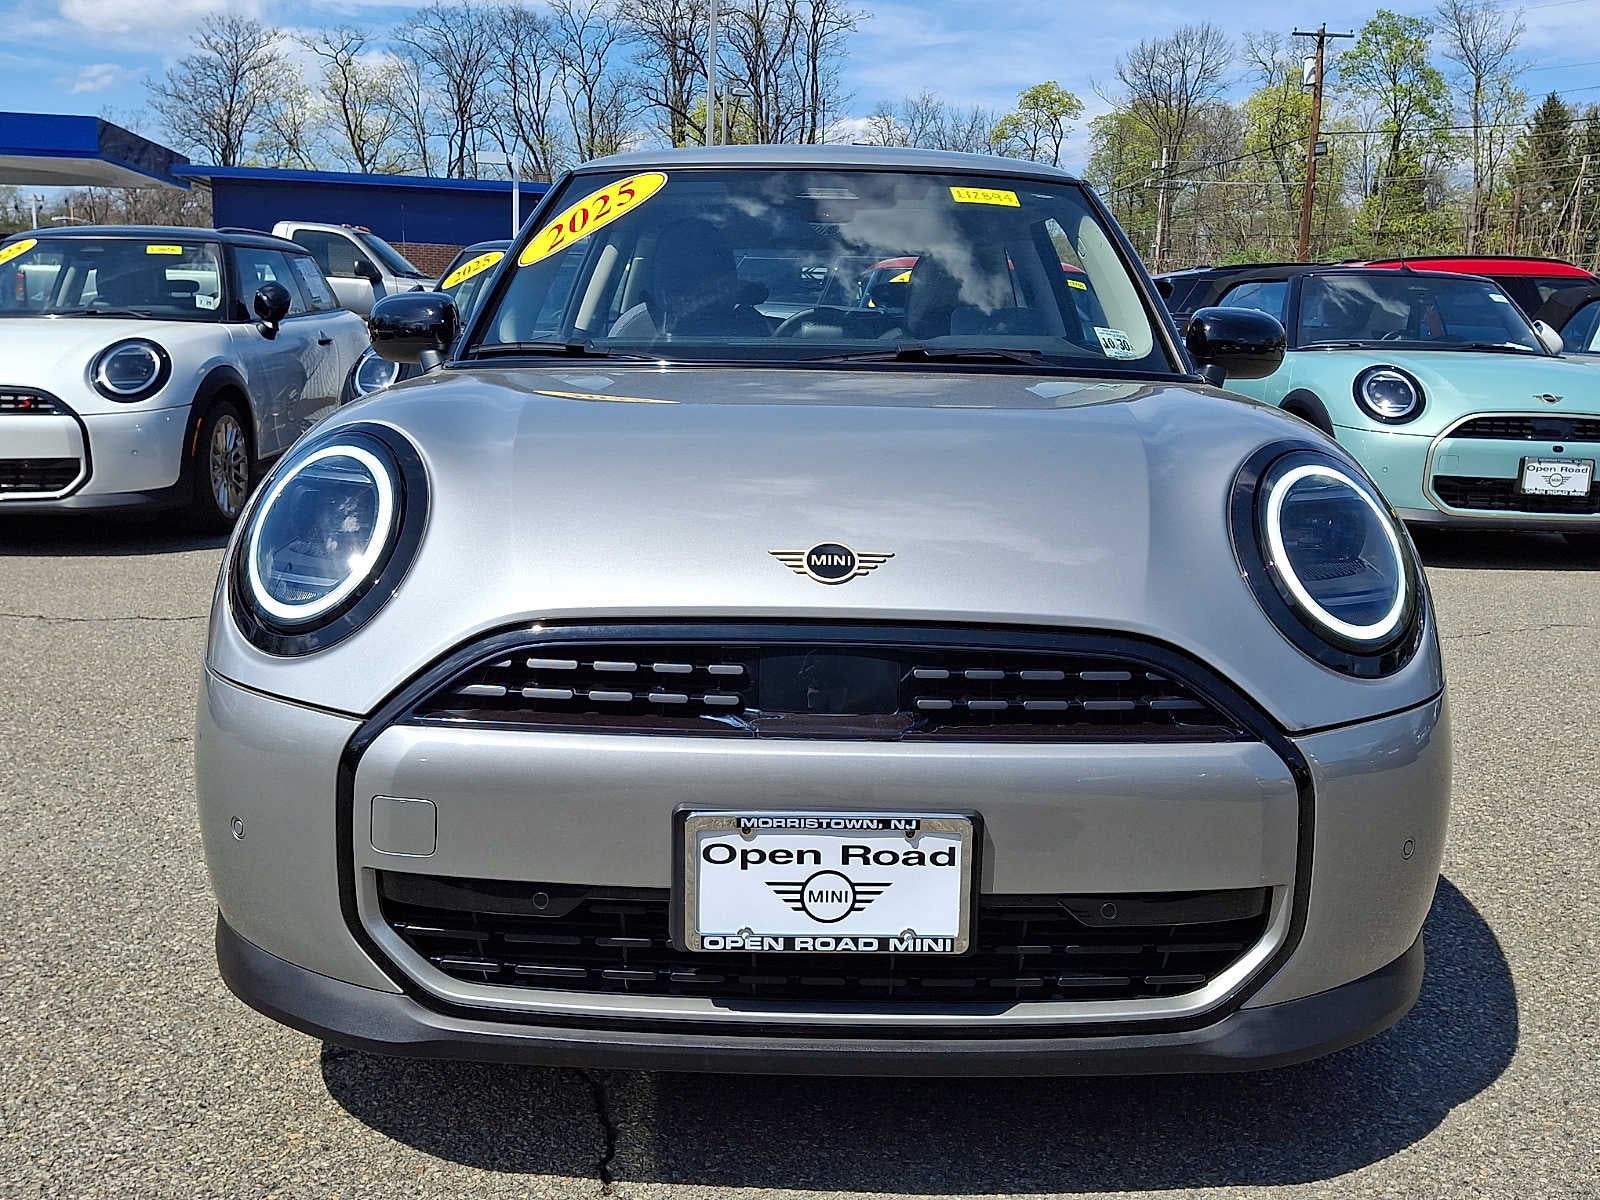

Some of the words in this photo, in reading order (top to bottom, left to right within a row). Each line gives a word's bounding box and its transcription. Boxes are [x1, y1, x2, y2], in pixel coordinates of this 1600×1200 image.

[547, 180, 636, 253] 2025
[453, 255, 491, 283] 2025
[1526, 464, 1557, 473] Open
[1560, 466, 1588, 474] Road
[810, 554, 851, 566] MINI
[740, 817, 883, 830] MORRISTOWN,
[890, 819, 917, 830] NJ
[702, 843, 822, 870] Open
[841, 845, 956, 867] Road
[808, 890, 849, 904] MINI
[703, 936, 785, 951] OPEN
[794, 937, 879, 952] ROAD
[889, 938, 952, 953] MINI
